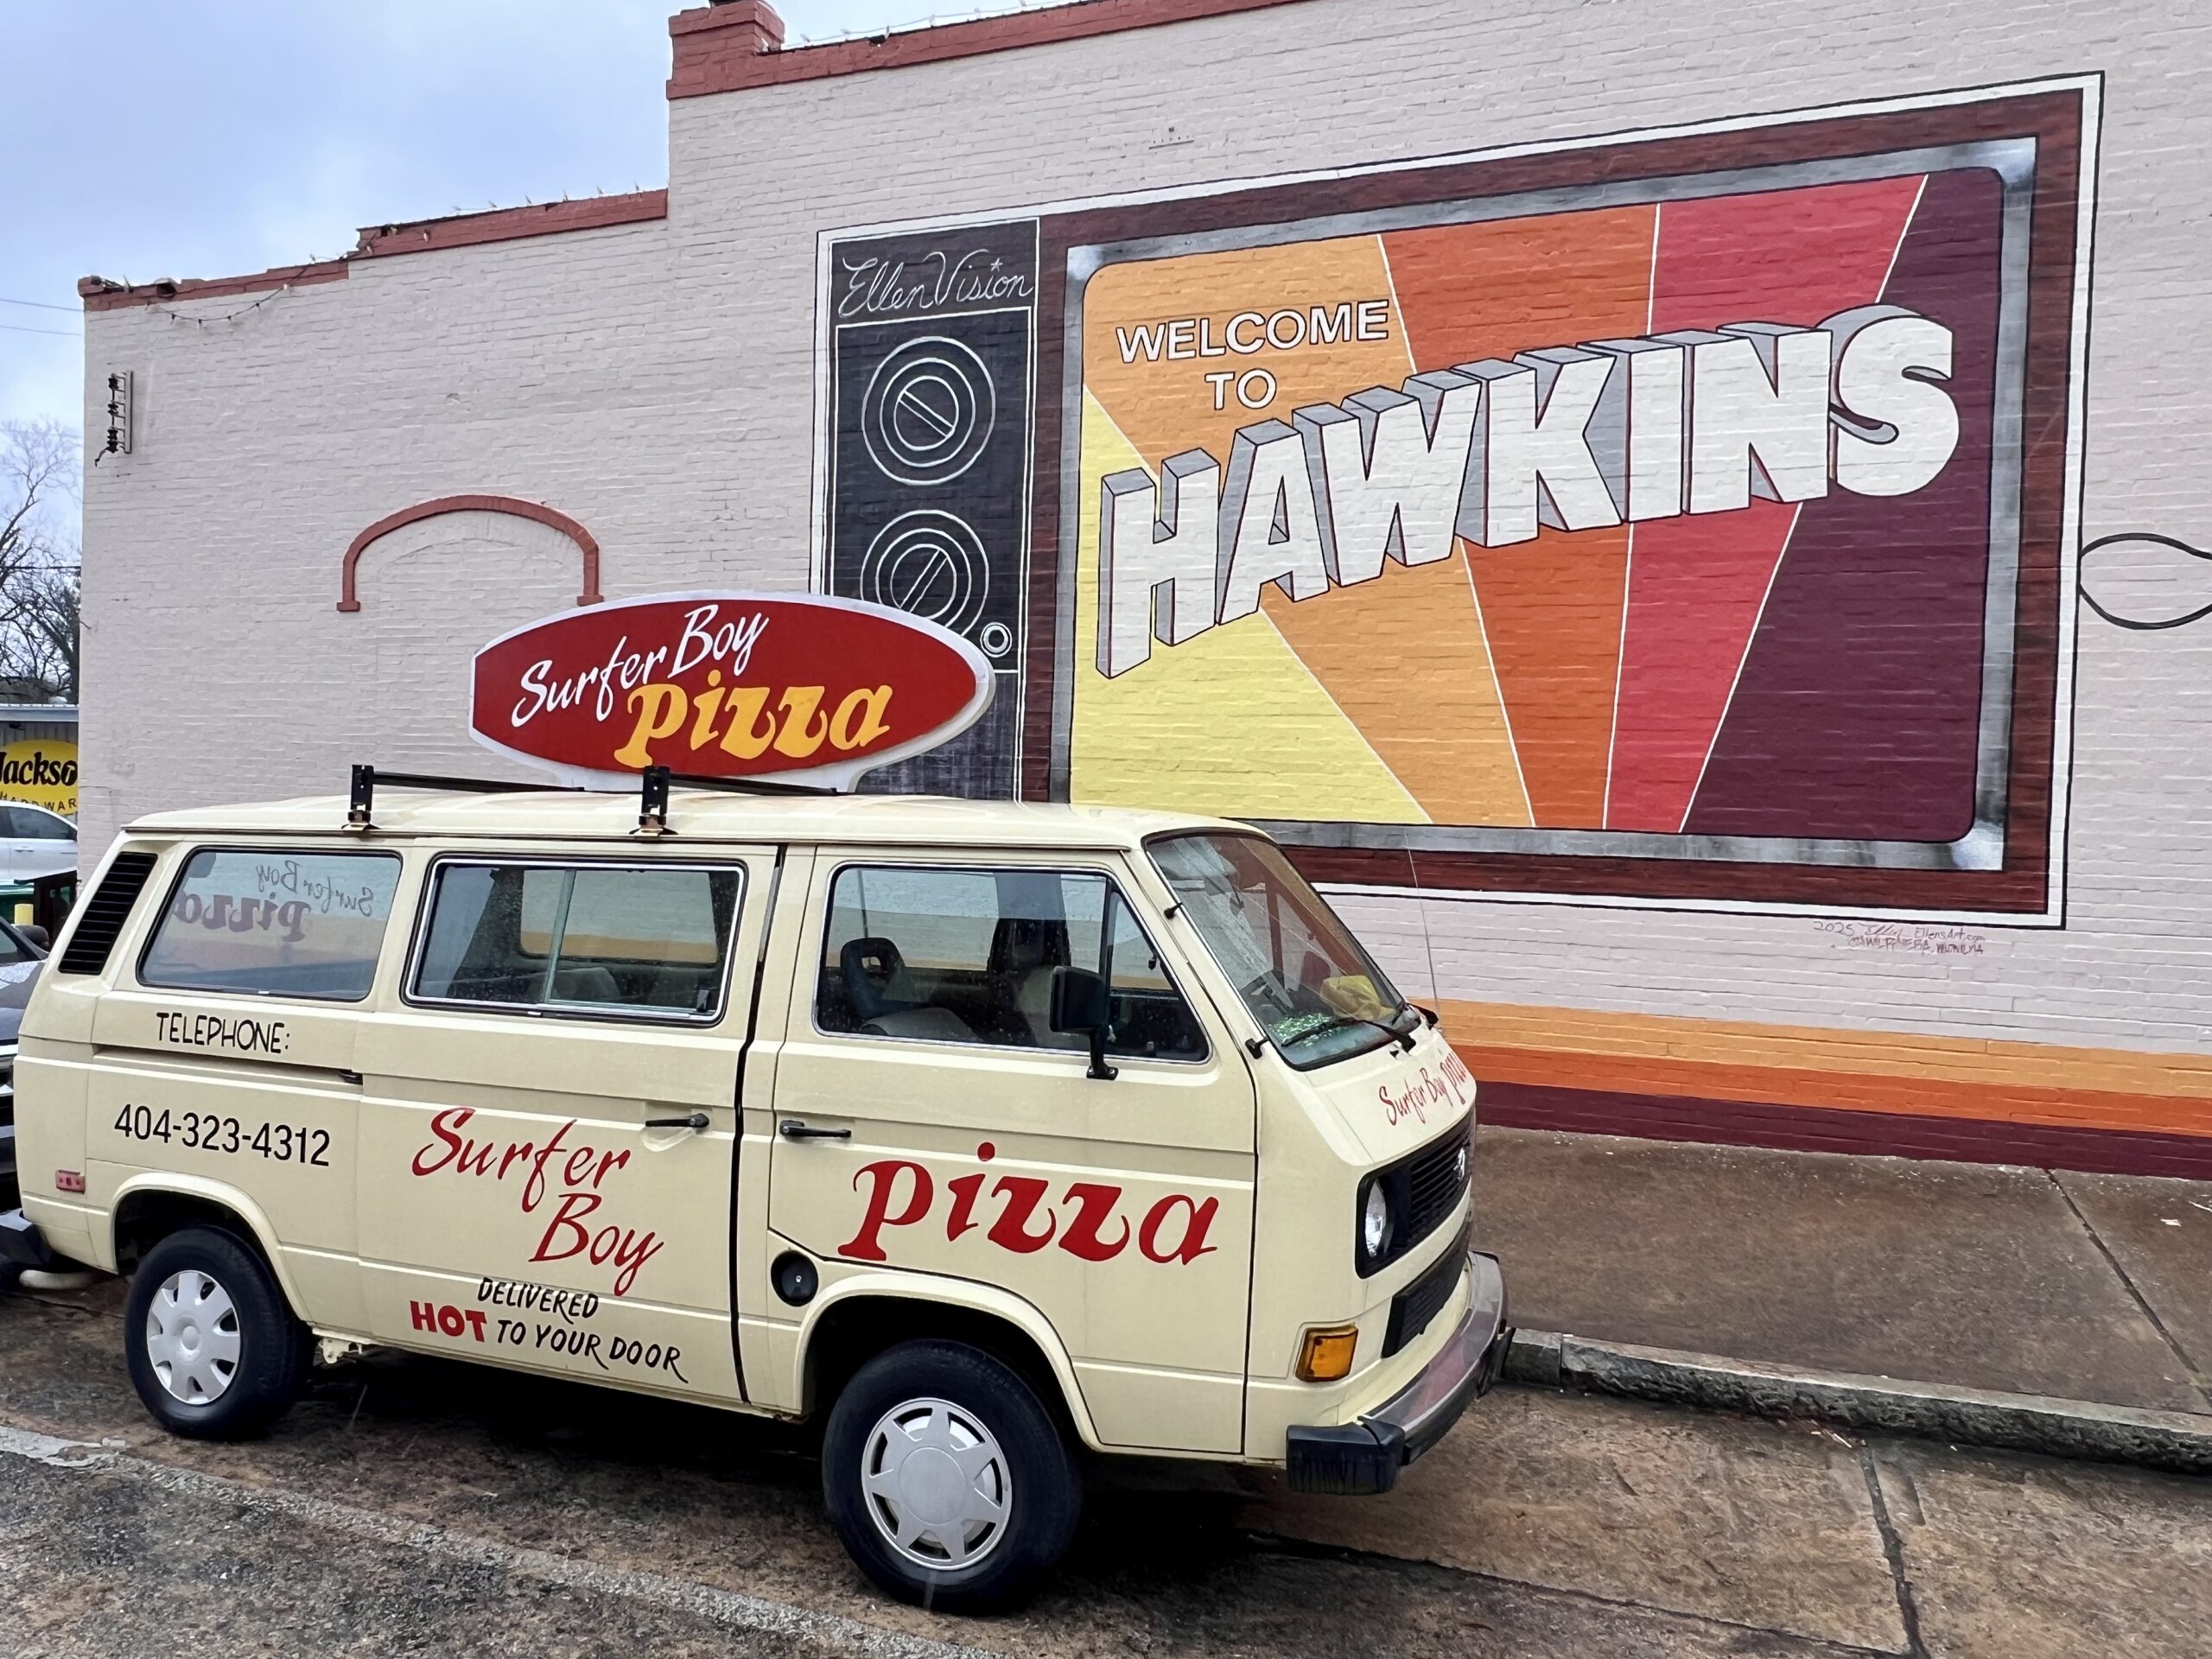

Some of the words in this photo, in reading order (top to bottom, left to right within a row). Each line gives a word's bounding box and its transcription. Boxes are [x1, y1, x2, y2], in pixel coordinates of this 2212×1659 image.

[838, 257, 934, 318] Ellen
[923, 249, 1034, 305] Vision
[1116, 299, 1389, 363] WELCOME
[1205, 368, 1277, 410] TO
[1096, 304, 1960, 679] HAWKINS
[512, 636, 667, 728] Surfer
[671, 604, 769, 679] Boy
[0, 751, 78, 786] Jackso
[1813, 921, 1855, 937] 2025
[156, 1012, 290, 1054] TELEPHONE:
[114, 1103, 330, 1166] 404-323-4312
[412, 1107, 631, 1213] Surfer
[528, 1192, 664, 1297] Boy
[477, 1277, 599, 1325] DELIVERED
[410, 1300, 487, 1343] HOT
[498, 1319, 526, 1345] TO
[536, 1325, 609, 1370] YOUR
[608, 1336, 689, 1384] DOOR
